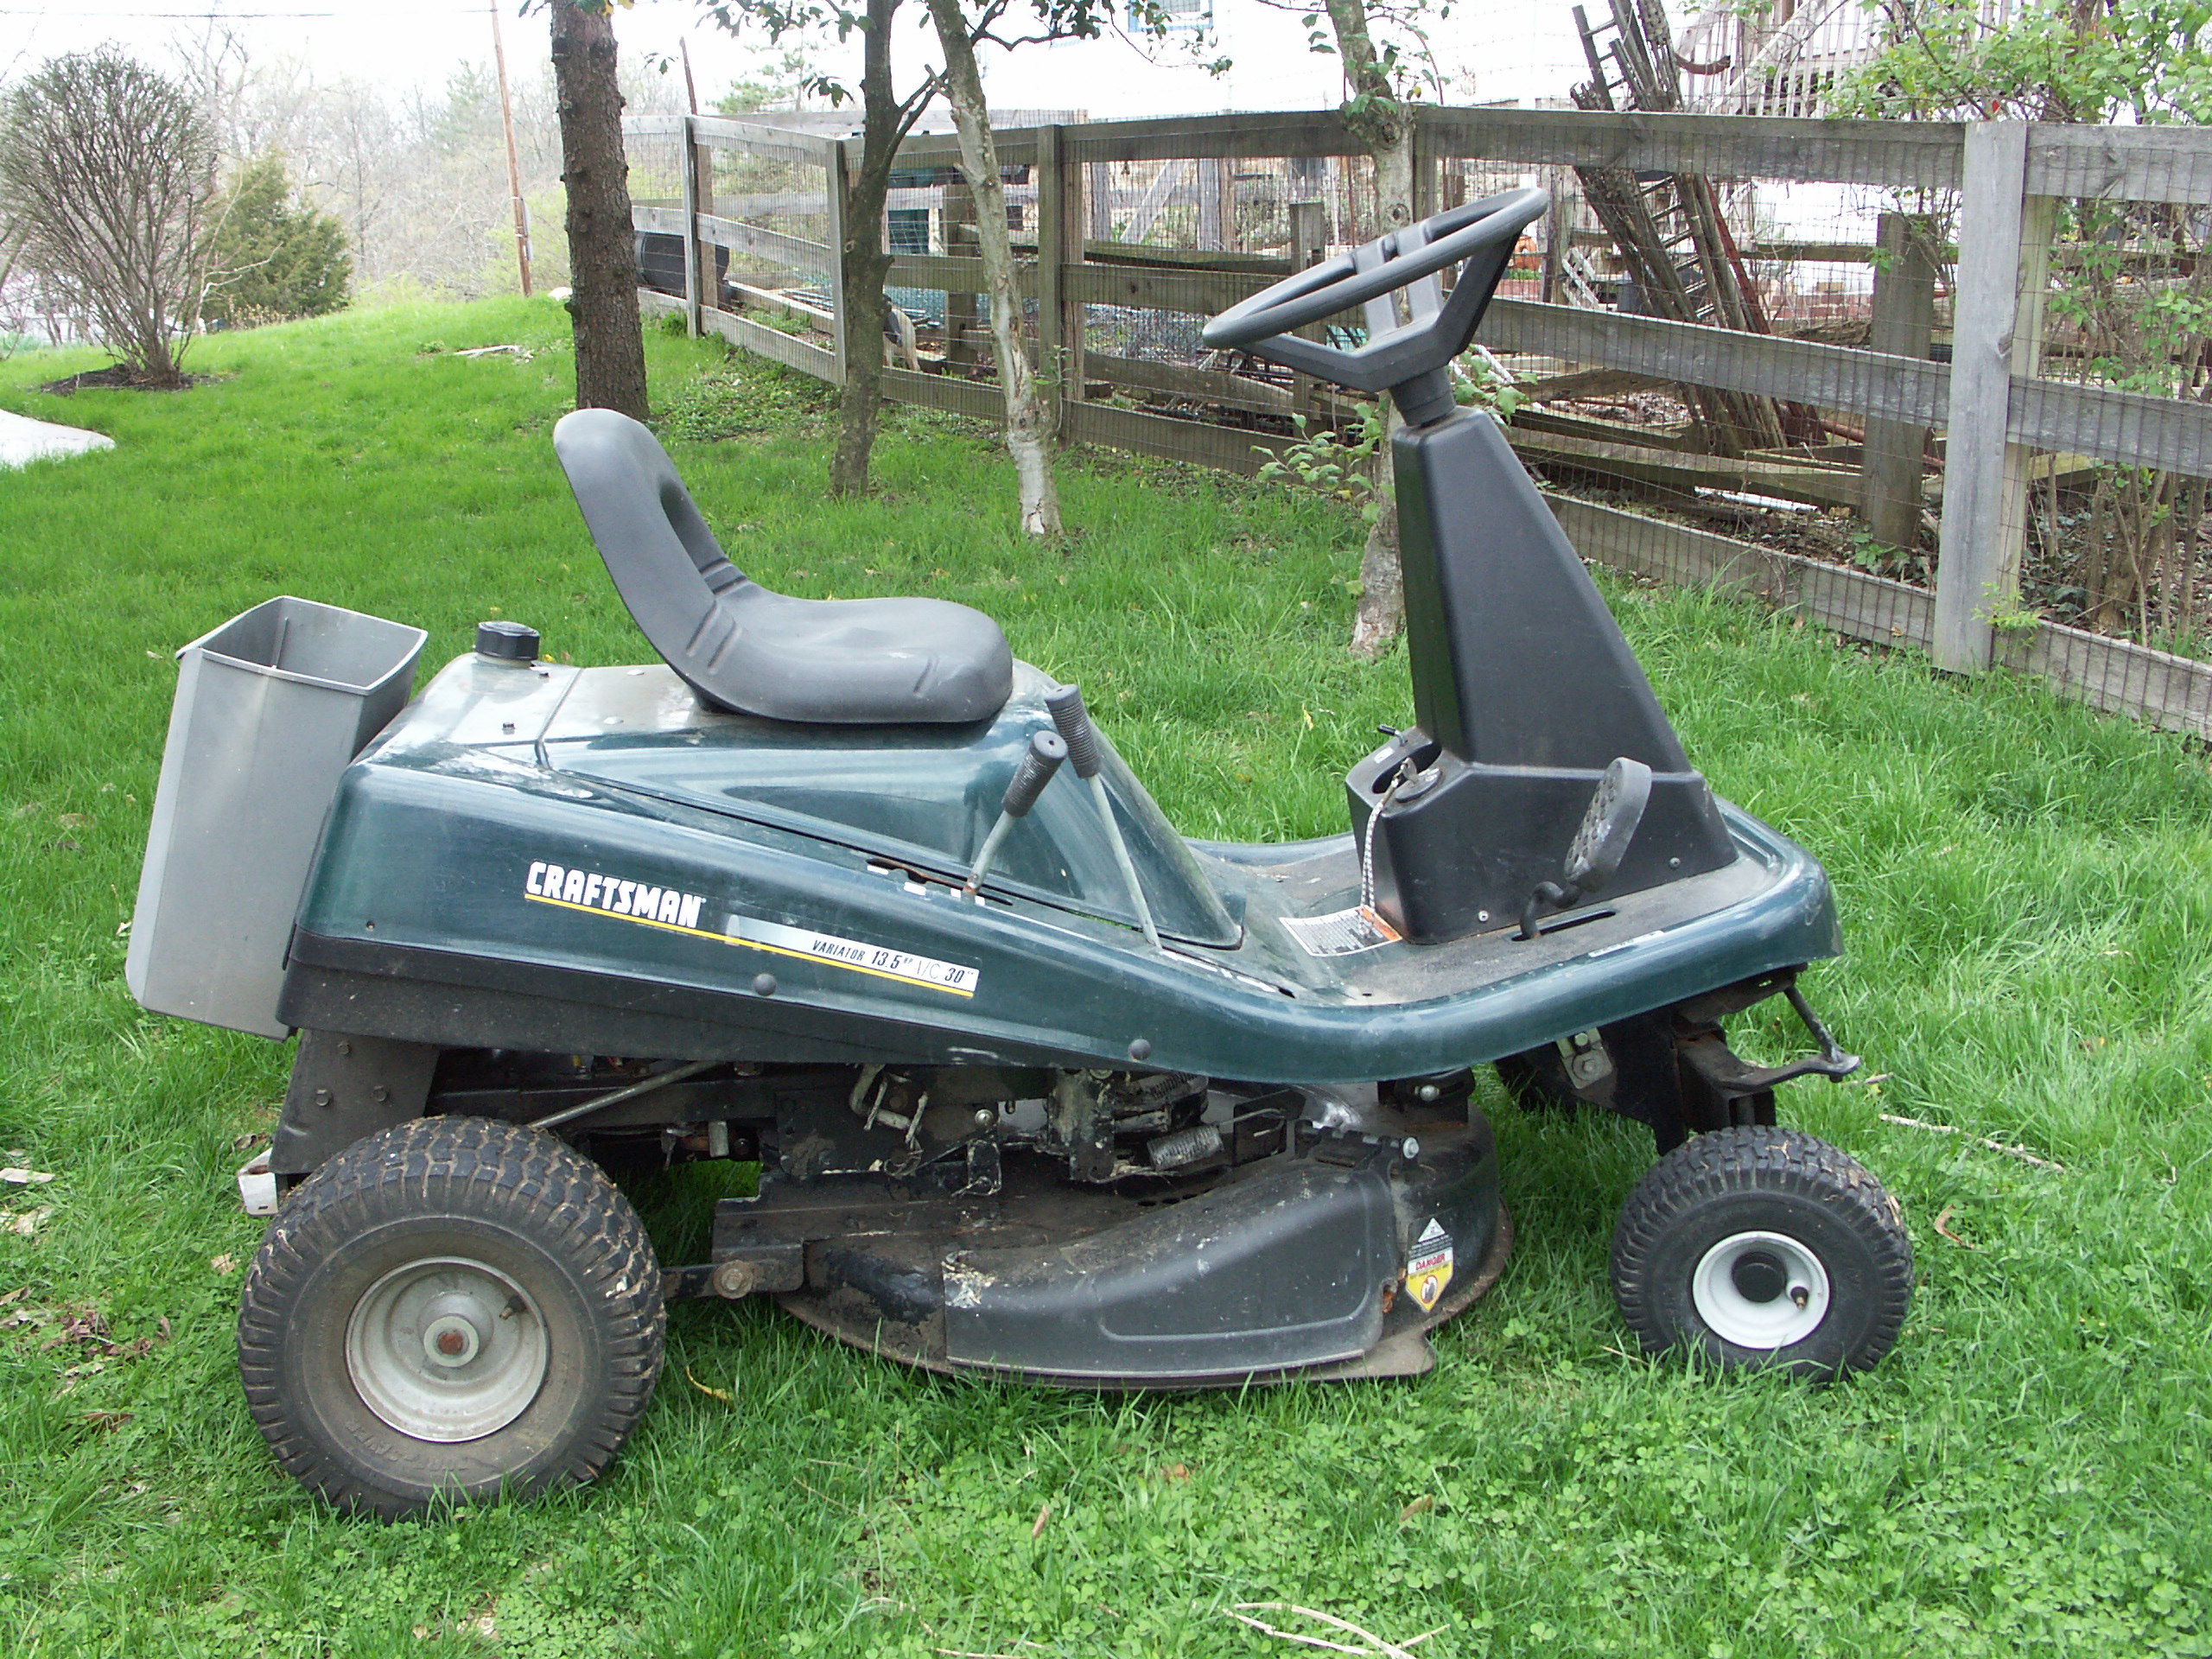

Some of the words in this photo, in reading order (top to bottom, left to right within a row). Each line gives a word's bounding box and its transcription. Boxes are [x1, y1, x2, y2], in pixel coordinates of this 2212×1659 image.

[525, 861, 702, 929] CRAFTSMAN
[811, 939, 866, 962] VARIATOR
[1415, 1253, 1446, 1271] DANGER
